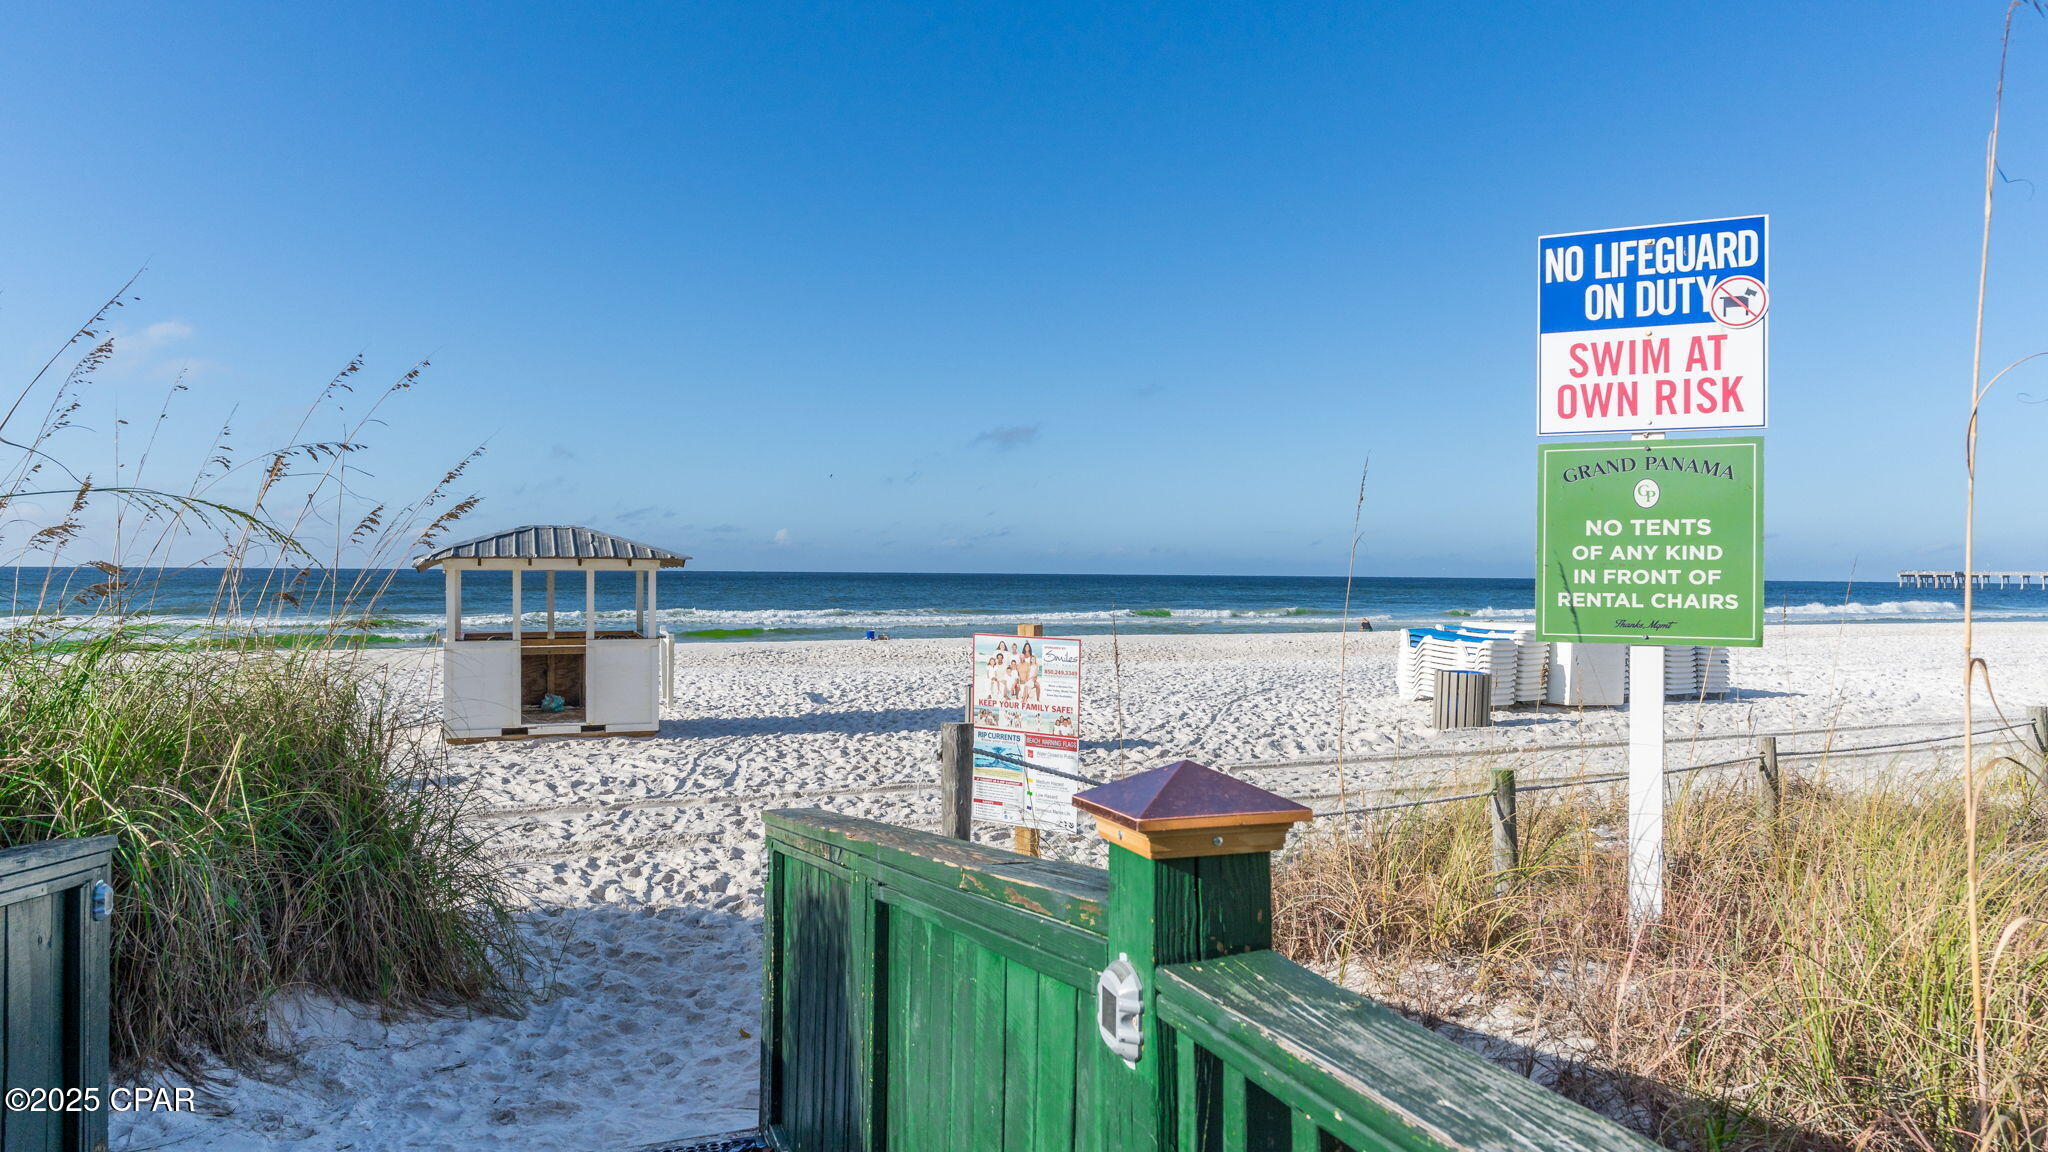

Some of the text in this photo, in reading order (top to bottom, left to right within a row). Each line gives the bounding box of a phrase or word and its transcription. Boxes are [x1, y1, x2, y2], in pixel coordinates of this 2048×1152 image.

[1545, 229, 1759, 284] NO LIFEGUARD
[1584, 275, 1718, 321] ON DUTY
[1569, 334, 1728, 379] SWIM AT
[1557, 375, 1744, 420] OWN RISK
[1563, 456, 1735, 483] GRAND PANAMA
[1585, 519, 1712, 537] NO TENTS
[1572, 545, 1724, 561] OF ANY KIND
[1573, 569, 1722, 585] IN FRONT OF
[1557, 592, 1739, 610] RENTAL CHAIRS
[1646, 620, 1678, 631] Mgmt
[1044, 649, 1078, 663] Smiles
[979, 699, 1074, 714] KEEP YOUR FAMILY SAFE!
[977, 731, 987, 739] RIP
[987, 732, 1021, 742] CURRENTS
